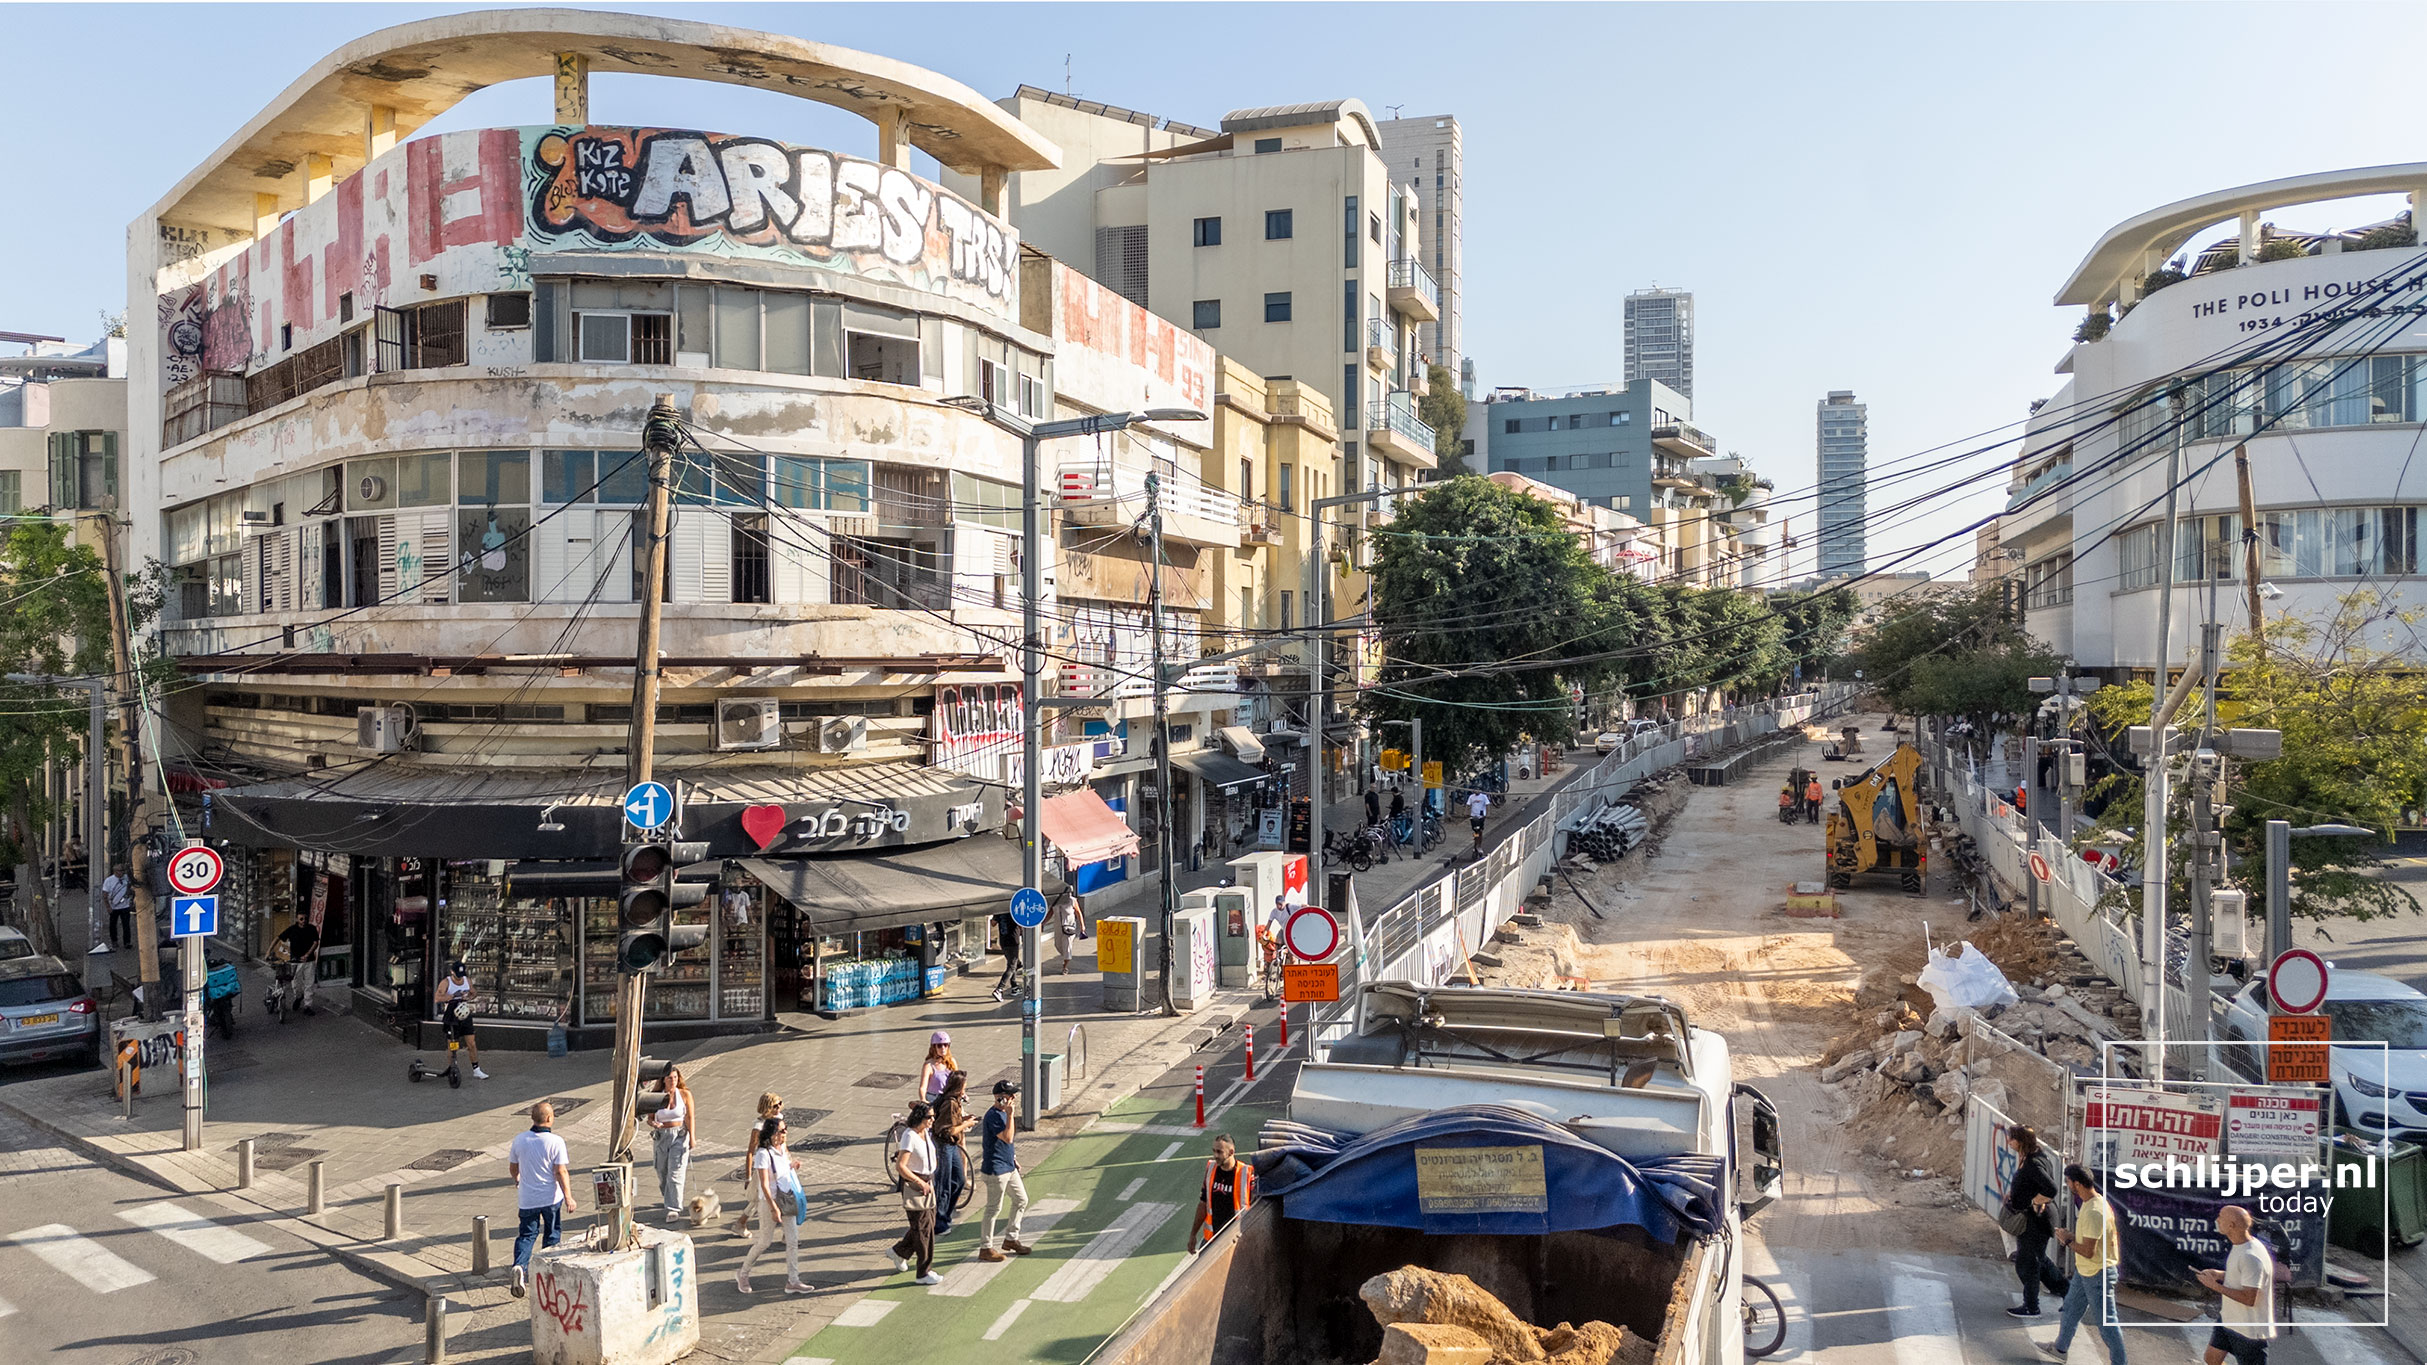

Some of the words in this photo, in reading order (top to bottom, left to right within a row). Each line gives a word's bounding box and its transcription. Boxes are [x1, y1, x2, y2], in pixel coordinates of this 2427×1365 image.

[630, 133, 931, 266] ARIES
[2193, 299, 2227, 318] THE
[2238, 288, 2289, 309] POLI
[2303, 278, 2394, 301] HOUSE
[2239, 316, 2282, 332] 1934
[1869, 773, 1883, 787] CAT
[167, 817, 199, 825] CNGE
[797, 808, 848, 838] בלב
[182, 862, 209, 879] 30
[1286, 969, 1308, 977] האתר
[1311, 968, 1335, 977] לעובדי
[1297, 980, 1325, 988] הכניסה
[2273, 1019, 2327, 1034] לעובדי
[2272, 1051, 2327, 1063] הכניסה
[2275, 1065, 2323, 1078] מותרת
[2257, 1098, 2289, 1109] סכנה
[2108, 1105, 2195, 1133] זהירות!
[2249, 1111, 2276, 1119] בונים
[2279, 1112, 2297, 1122] כאן
[2133, 1133, 2167, 1148] בניה
[2174, 1137, 2209, 1154] אתר
[2126, 1211, 2174, 1231] הסגול
[2180, 1218, 2208, 1233] הקו
[2285, 1219, 2302, 1232] גם
[2176, 1237, 2220, 1254] הקלה
